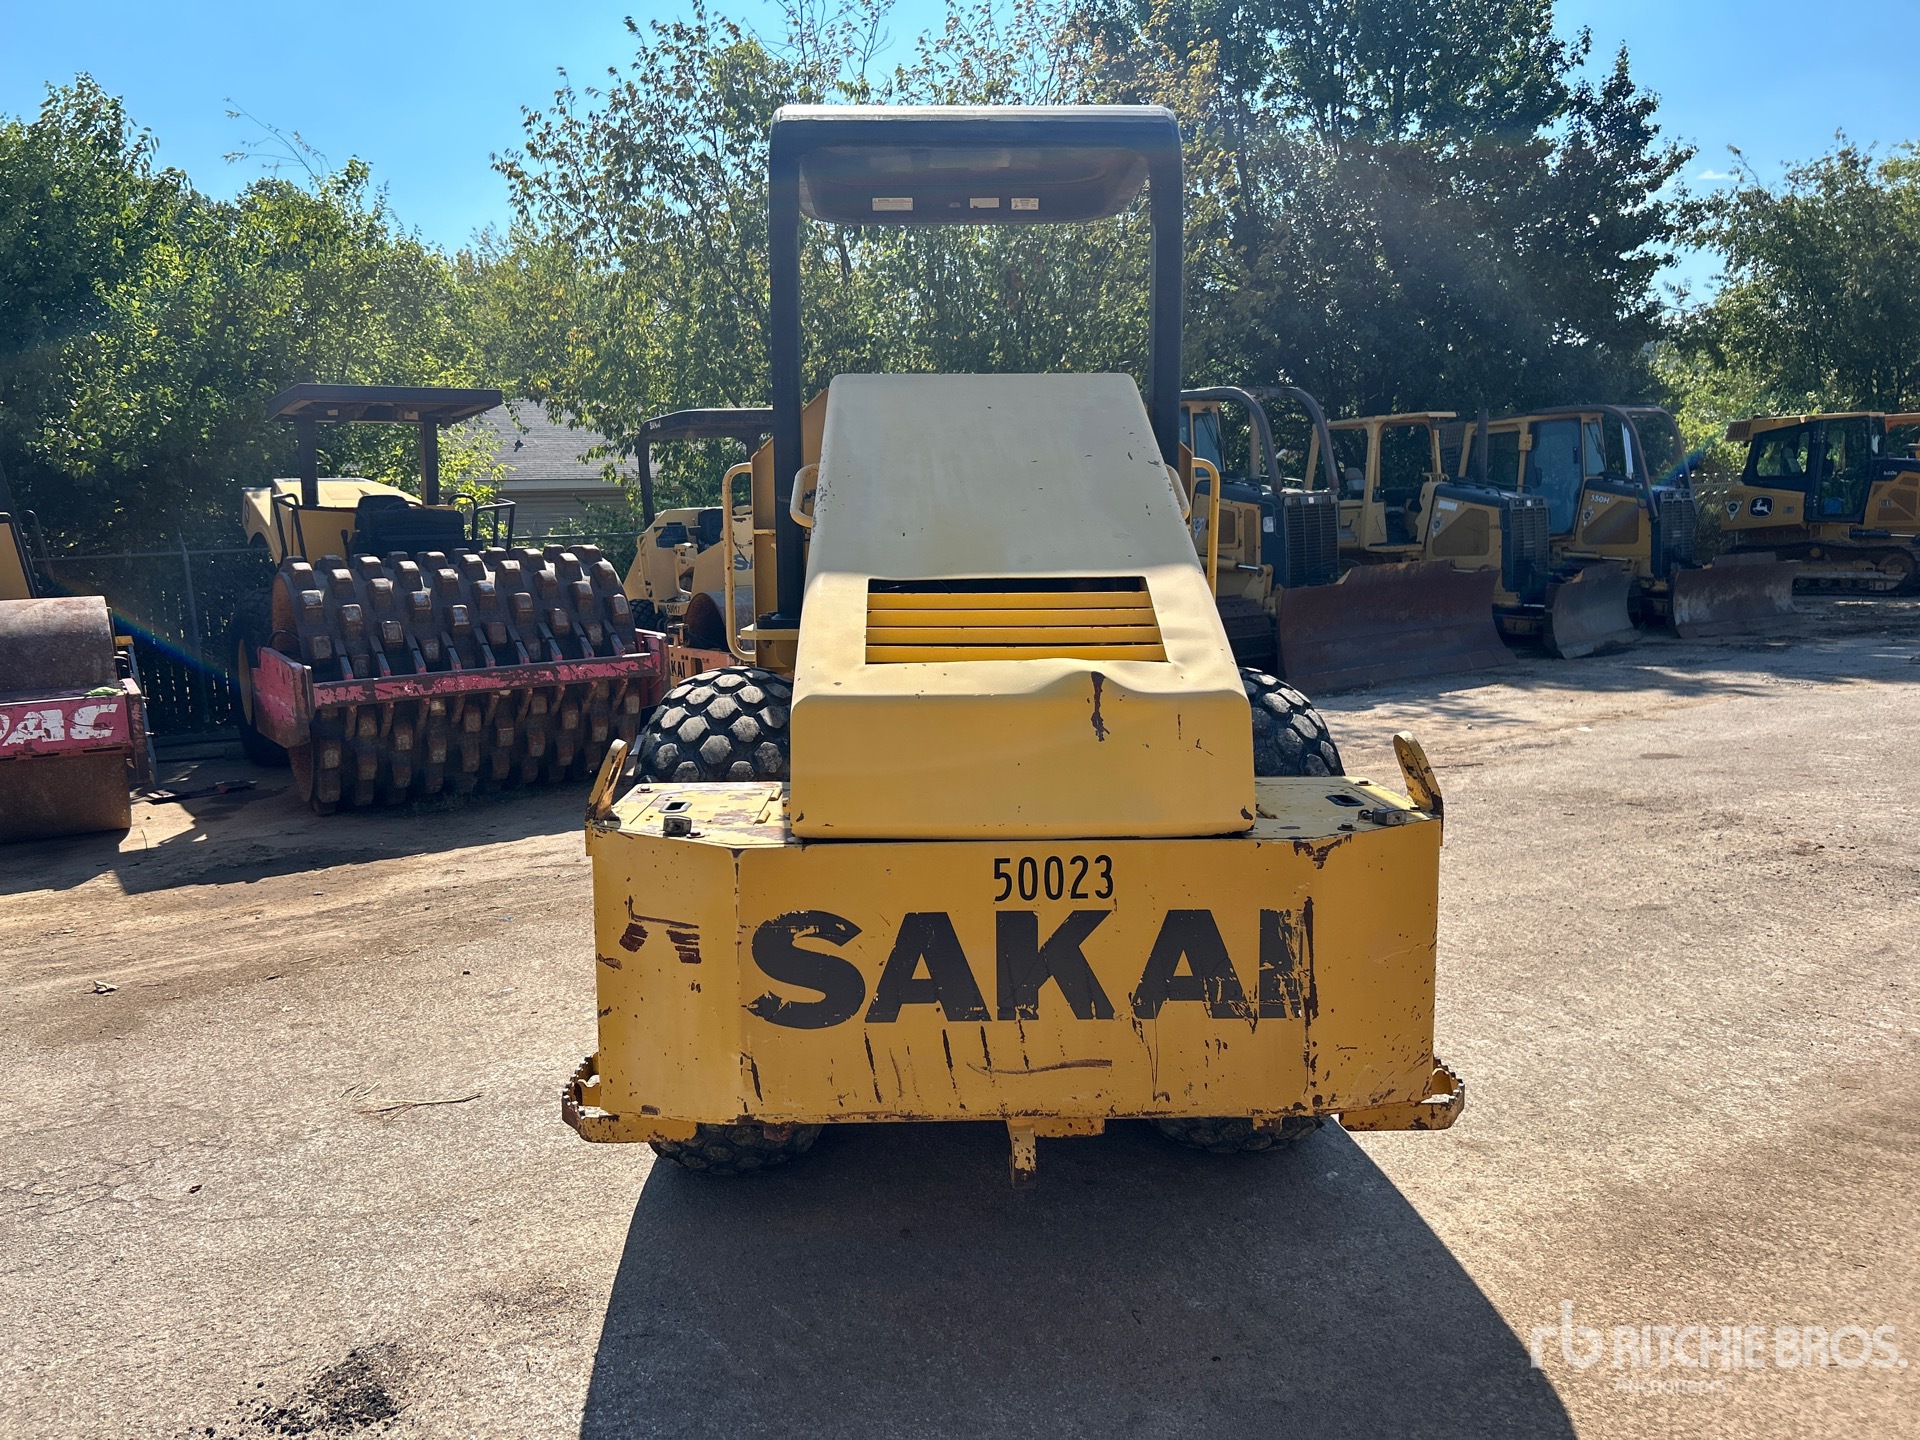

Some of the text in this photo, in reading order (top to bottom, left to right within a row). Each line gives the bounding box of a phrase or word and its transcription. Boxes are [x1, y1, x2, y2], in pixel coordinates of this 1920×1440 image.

[670, 660, 686, 679] KAI
[994, 855, 1114, 902] 50023
[745, 909, 1304, 1030] SAKAI
